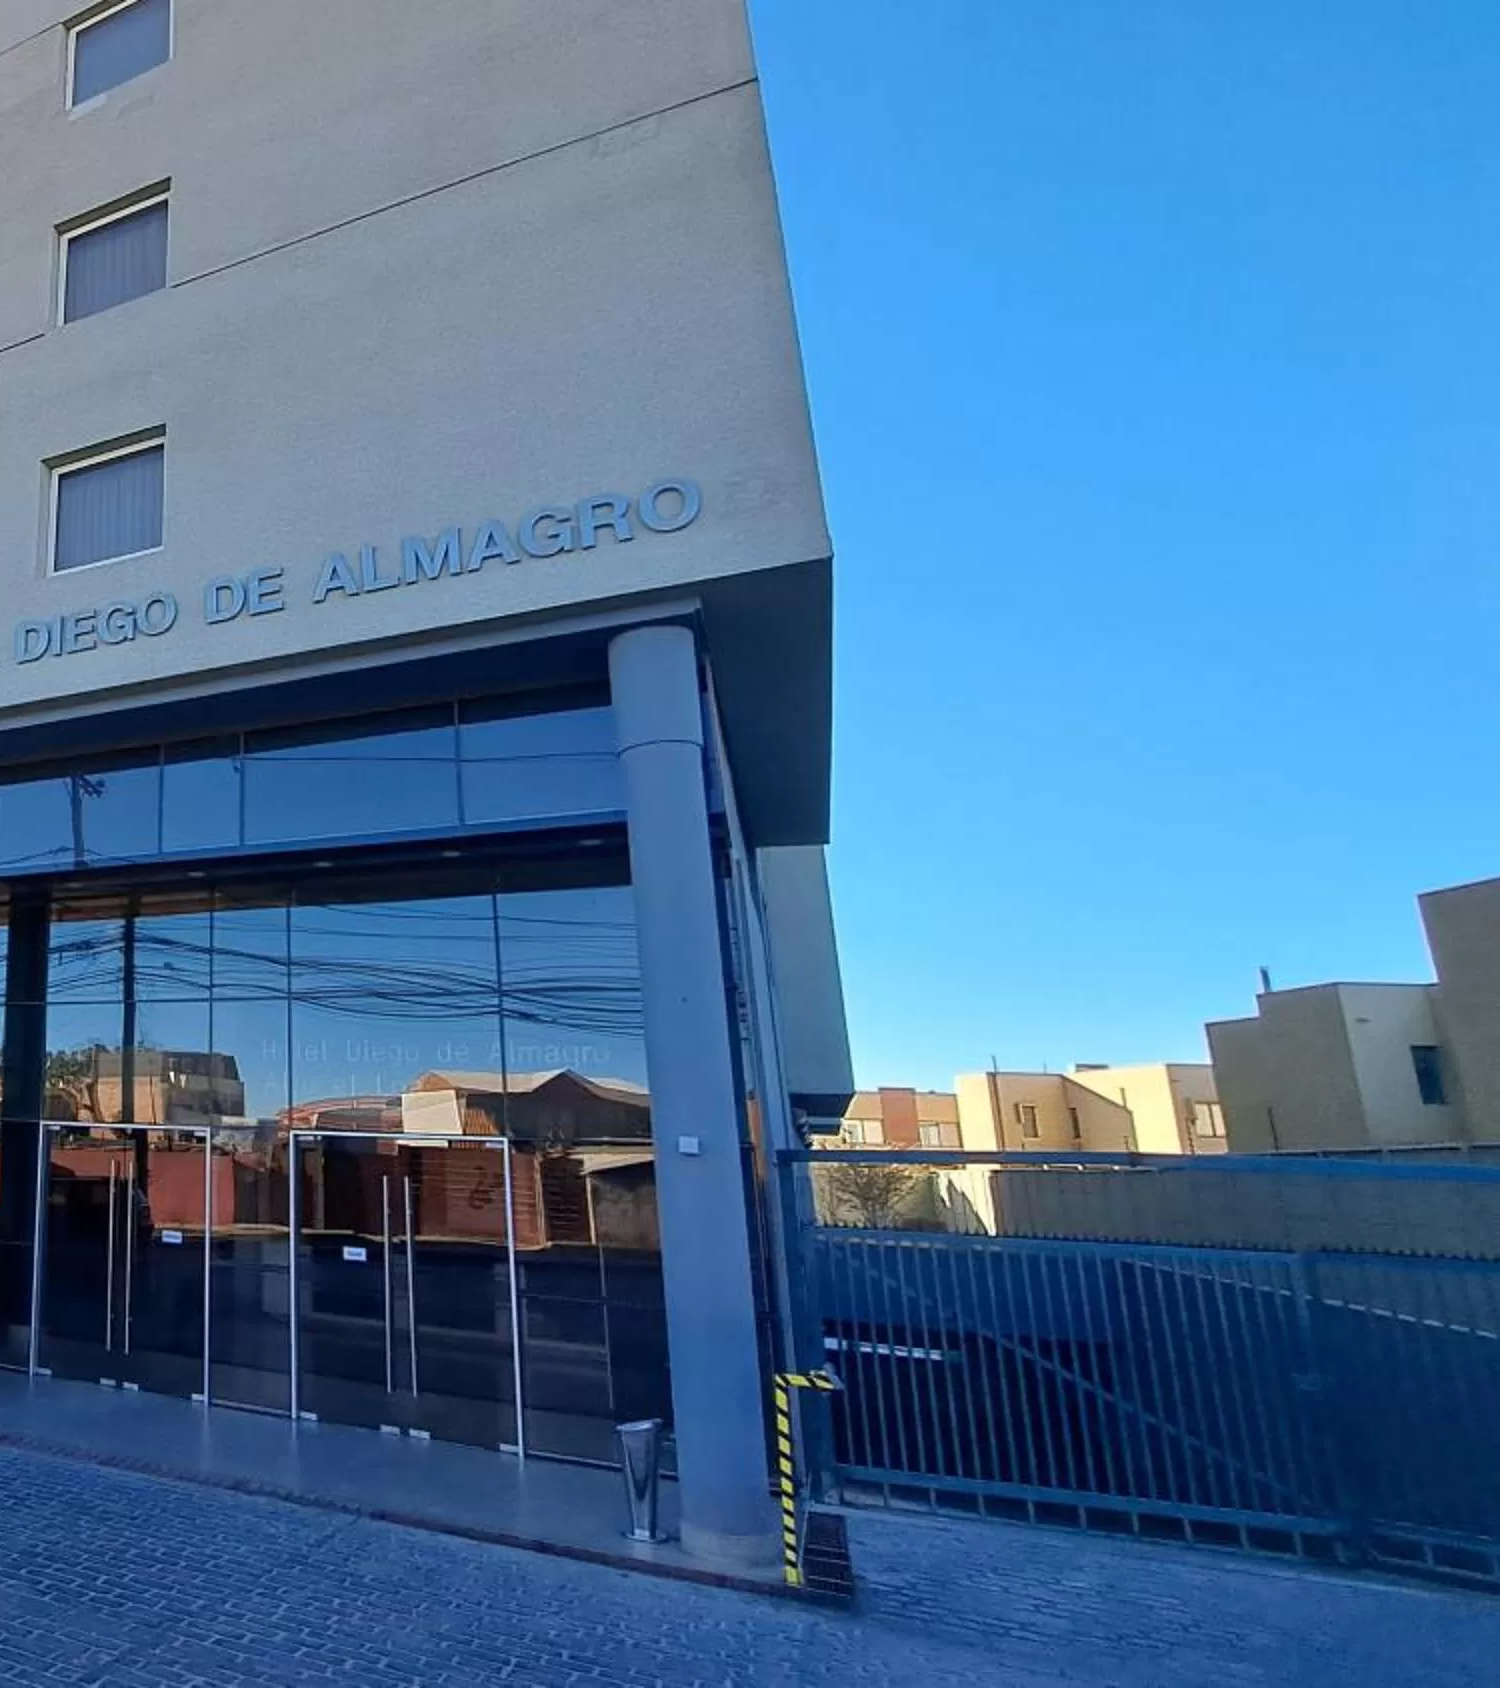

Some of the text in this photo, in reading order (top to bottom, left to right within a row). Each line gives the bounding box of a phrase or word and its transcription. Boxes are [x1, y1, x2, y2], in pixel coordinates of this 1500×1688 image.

[13, 591, 178, 664] DIEGO
[204, 565, 286, 626] DE
[312, 479, 701, 603] ALMAGRO
[262, 1039, 328, 1062] Htel
[437, 1040, 469, 1062] de
